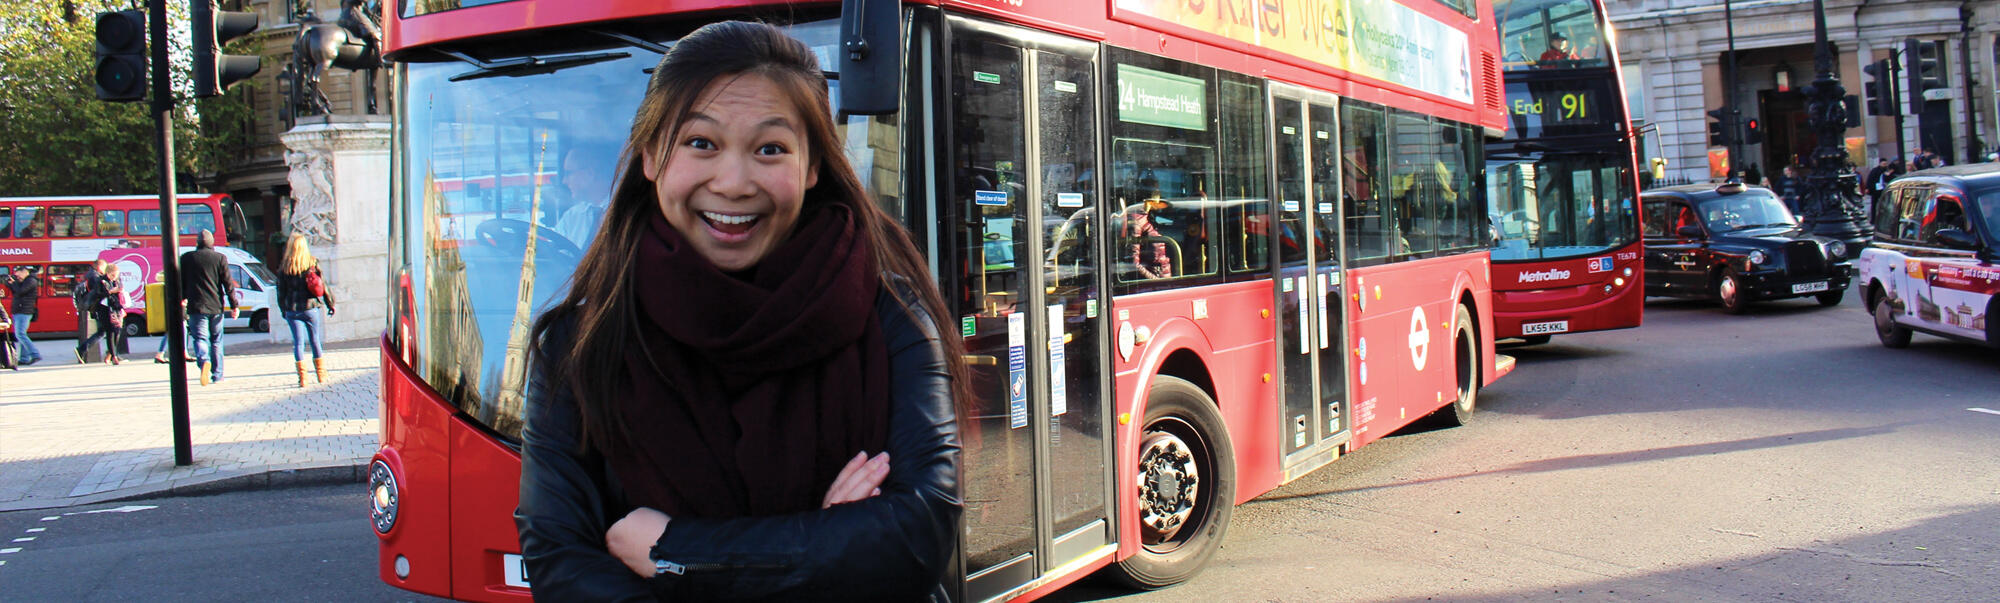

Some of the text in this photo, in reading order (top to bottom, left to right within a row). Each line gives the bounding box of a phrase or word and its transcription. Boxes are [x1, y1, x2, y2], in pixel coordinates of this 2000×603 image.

[1118, 79, 1201, 115] 24 Hampstead Heath
[1515, 98, 1543, 115] End
[1561, 93, 1585, 119] 91
[1518, 268, 1571, 283] Metroline
[1525, 322, 1565, 333] LK55 KKL
